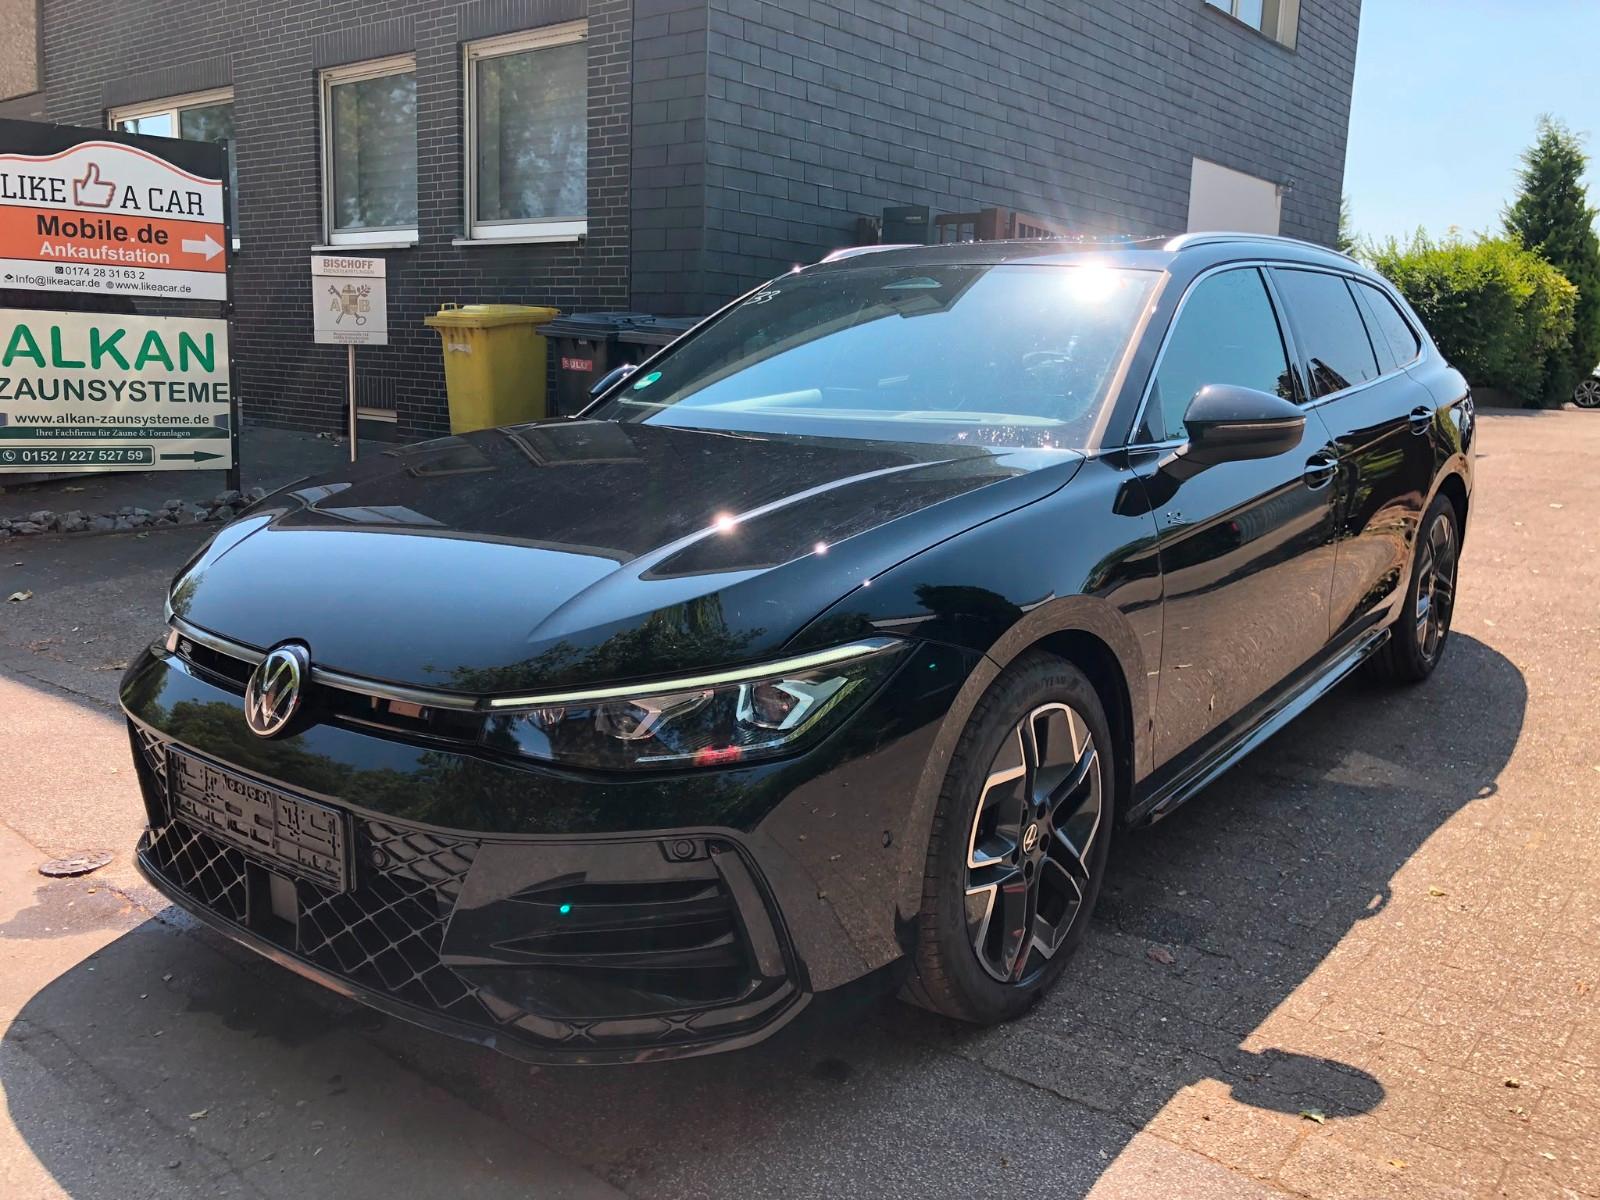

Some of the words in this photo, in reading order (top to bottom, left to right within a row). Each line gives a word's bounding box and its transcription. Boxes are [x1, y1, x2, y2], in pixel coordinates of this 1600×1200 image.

[1, 173, 67, 203] LIKE
[120, 185, 141, 210] A
[149, 187, 205, 216] CAR
[37, 214, 169, 245] Mobile.de
[39, 241, 170, 265] Ankaufstation
[323, 258, 374, 270] BISCHOFF
[65, 266, 90, 276] 0174
[93, 268, 106, 277] 28
[108, 269, 120, 278] 31
[123, 270, 136, 279] 63
[138, 271, 145, 280] 2
[115, 281, 192, 293] www.likeacar.de
[2, 323, 215, 373] ALKAN
[0, 377, 229, 403] ZAUNSYSTEME
[15, 413, 210, 427] www.alkan-zaunsysteme.de
[36, 429, 53, 437] Ihre
[55, 429, 96, 437] Fachfirma
[149, 429, 191, 438] Toranlagen
[22, 450, 58, 462] 0152
[69, 450, 95, 461] 227
[98, 450, 124, 461] 527
[127, 450, 143, 461] 59
